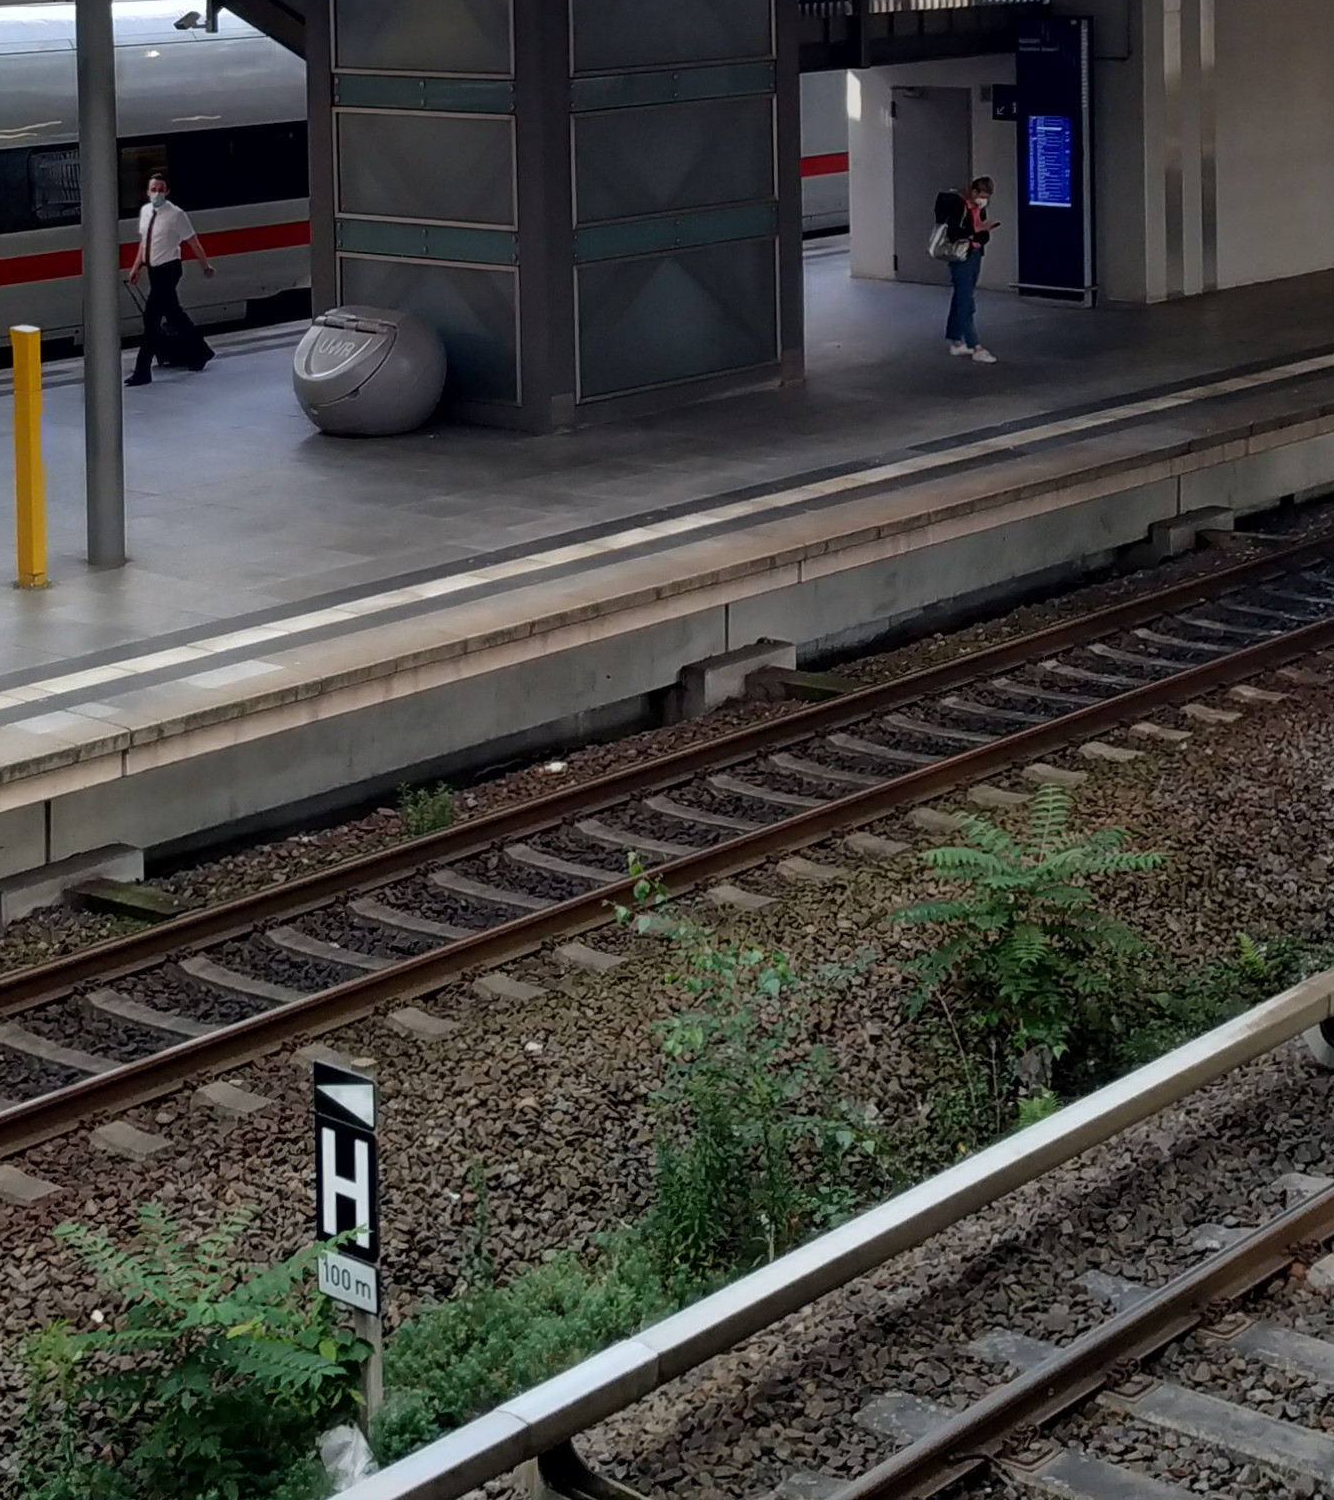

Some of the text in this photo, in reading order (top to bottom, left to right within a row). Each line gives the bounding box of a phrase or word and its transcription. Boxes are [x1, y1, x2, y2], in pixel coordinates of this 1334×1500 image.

[322, 1126, 369, 1249] H
[323, 1261, 372, 1300] 100 m
